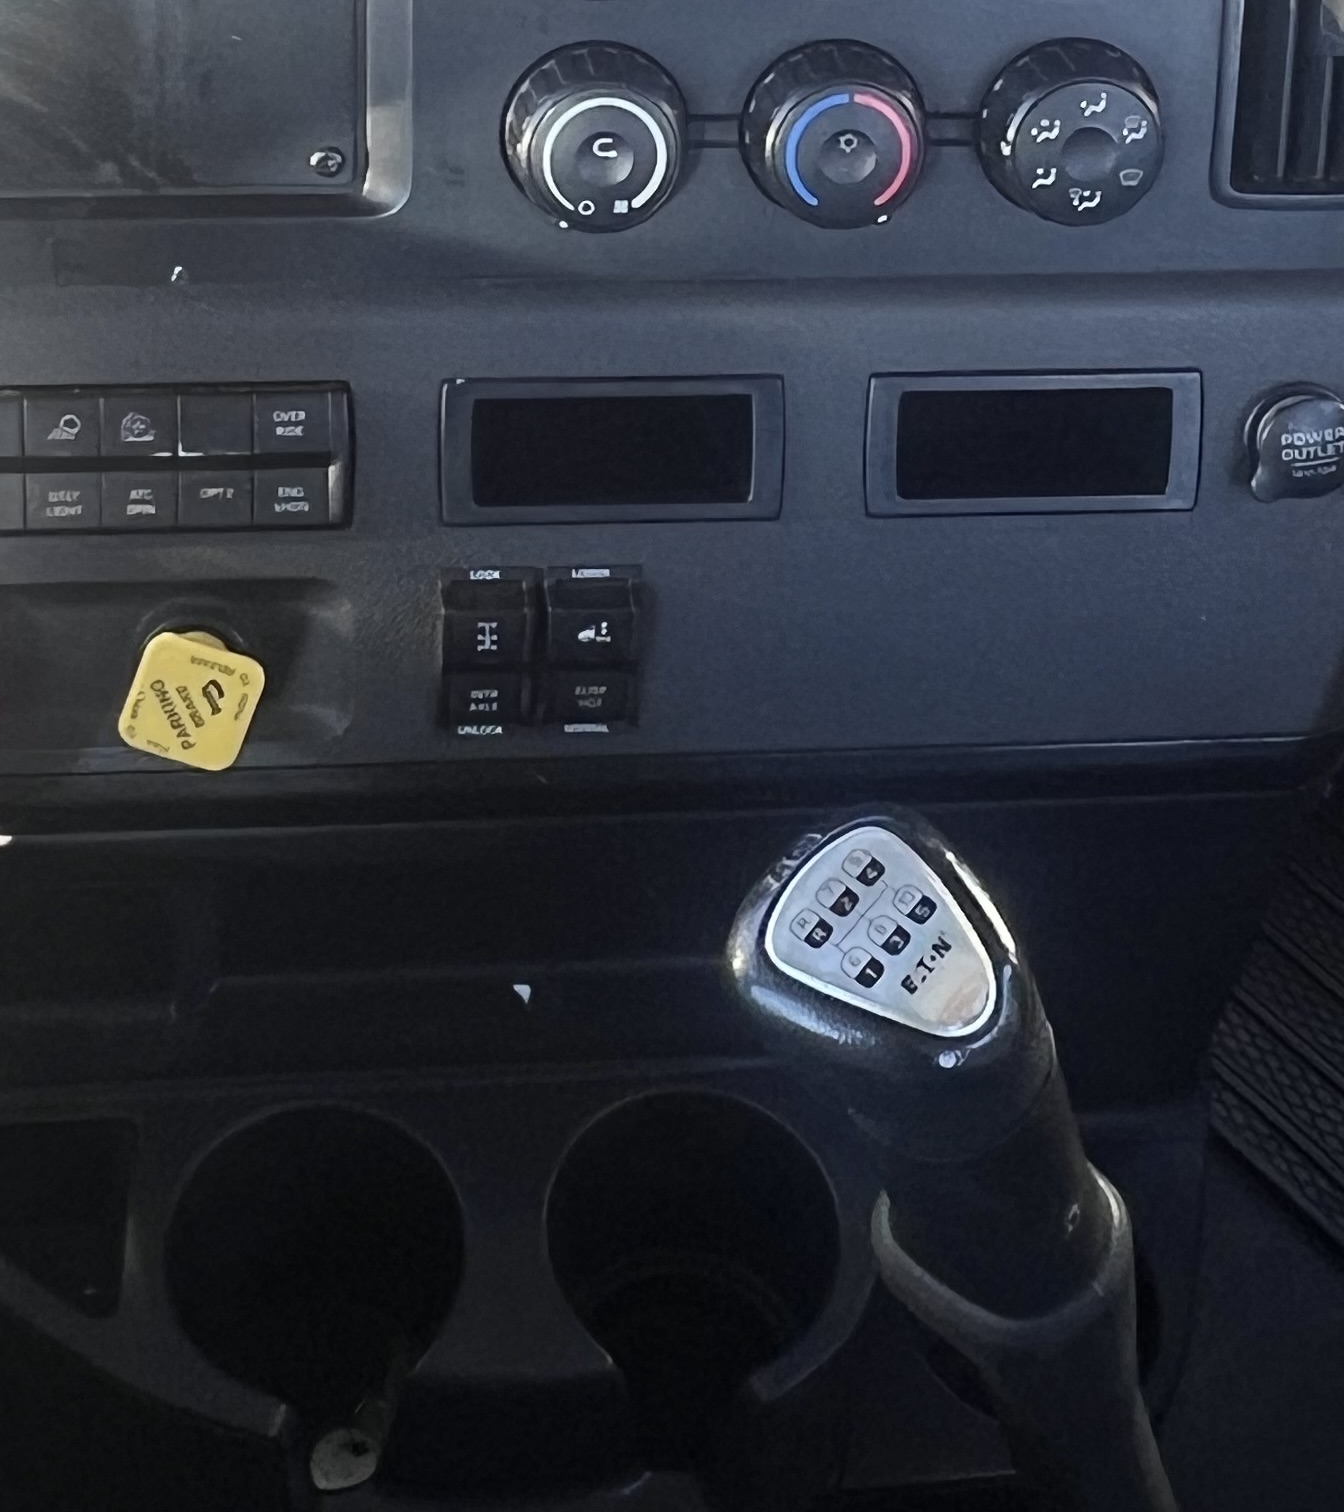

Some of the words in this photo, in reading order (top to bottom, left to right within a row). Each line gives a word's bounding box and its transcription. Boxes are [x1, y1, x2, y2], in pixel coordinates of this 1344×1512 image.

[842, 896, 854, 910] 2
[915, 903, 930, 918] 5
[812, 927, 827, 942] R
[864, 967, 878, 980] 1
